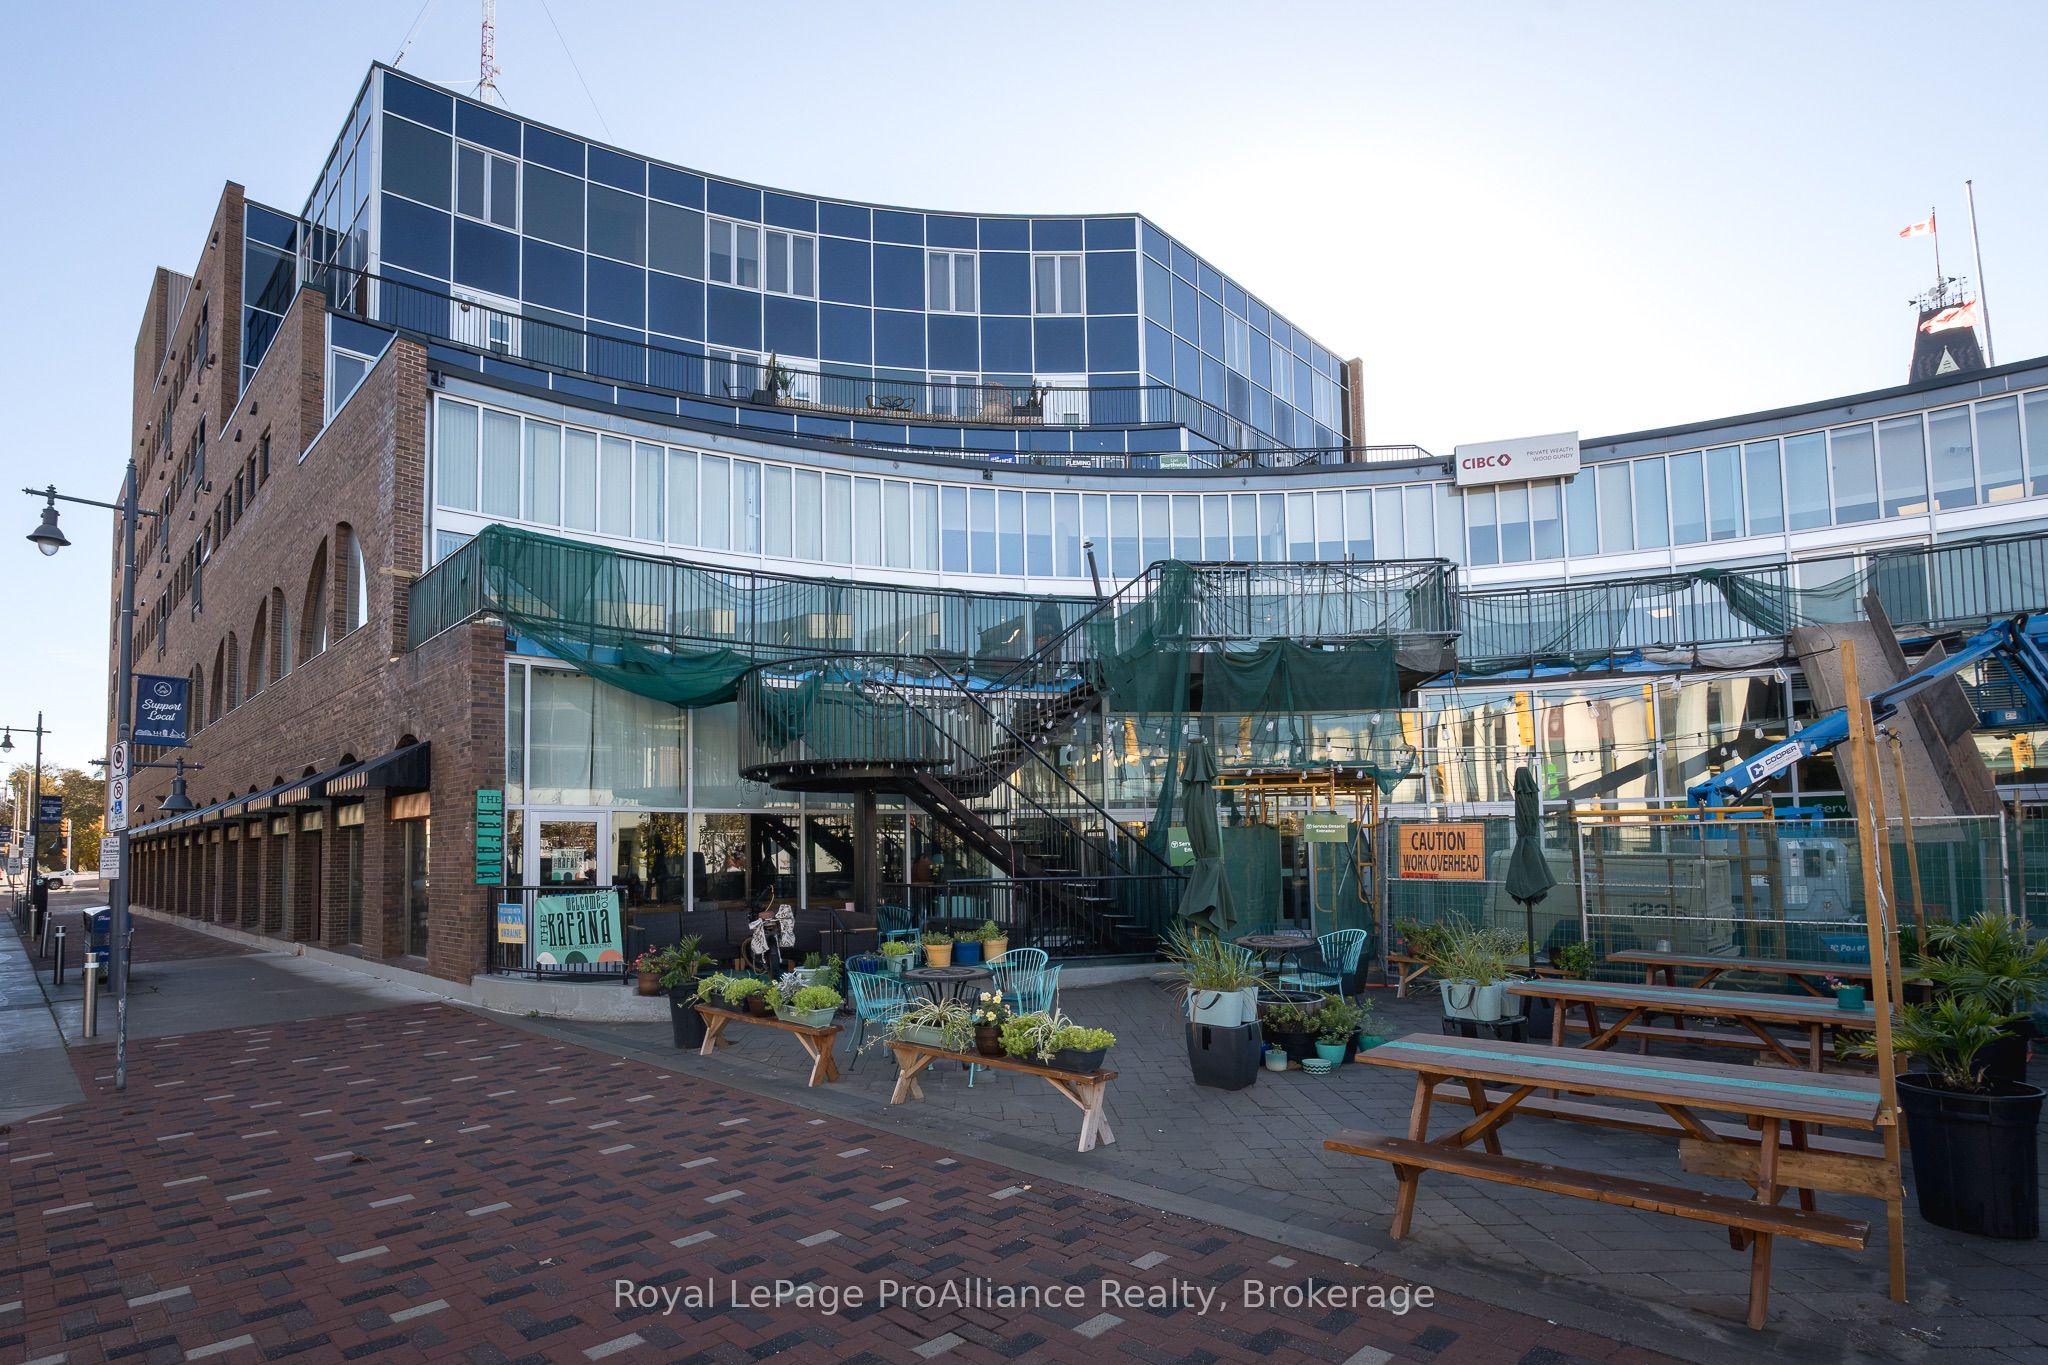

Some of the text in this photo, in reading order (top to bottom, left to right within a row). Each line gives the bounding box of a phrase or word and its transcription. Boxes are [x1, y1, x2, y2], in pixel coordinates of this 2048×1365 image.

[1462, 456, 1495, 469] CIBC
[142, 699, 182, 711] Support
[147, 711, 176, 720] Local
[1765, 745, 1797, 765] COOPER
[480, 795, 502, 804] THE
[1411, 831, 1466, 851] CAUTION
[1403, 854, 1480, 872] WORK OVERHEAD
[501, 929, 522, 938] UKRAINE
[540, 914, 548, 945] THE
